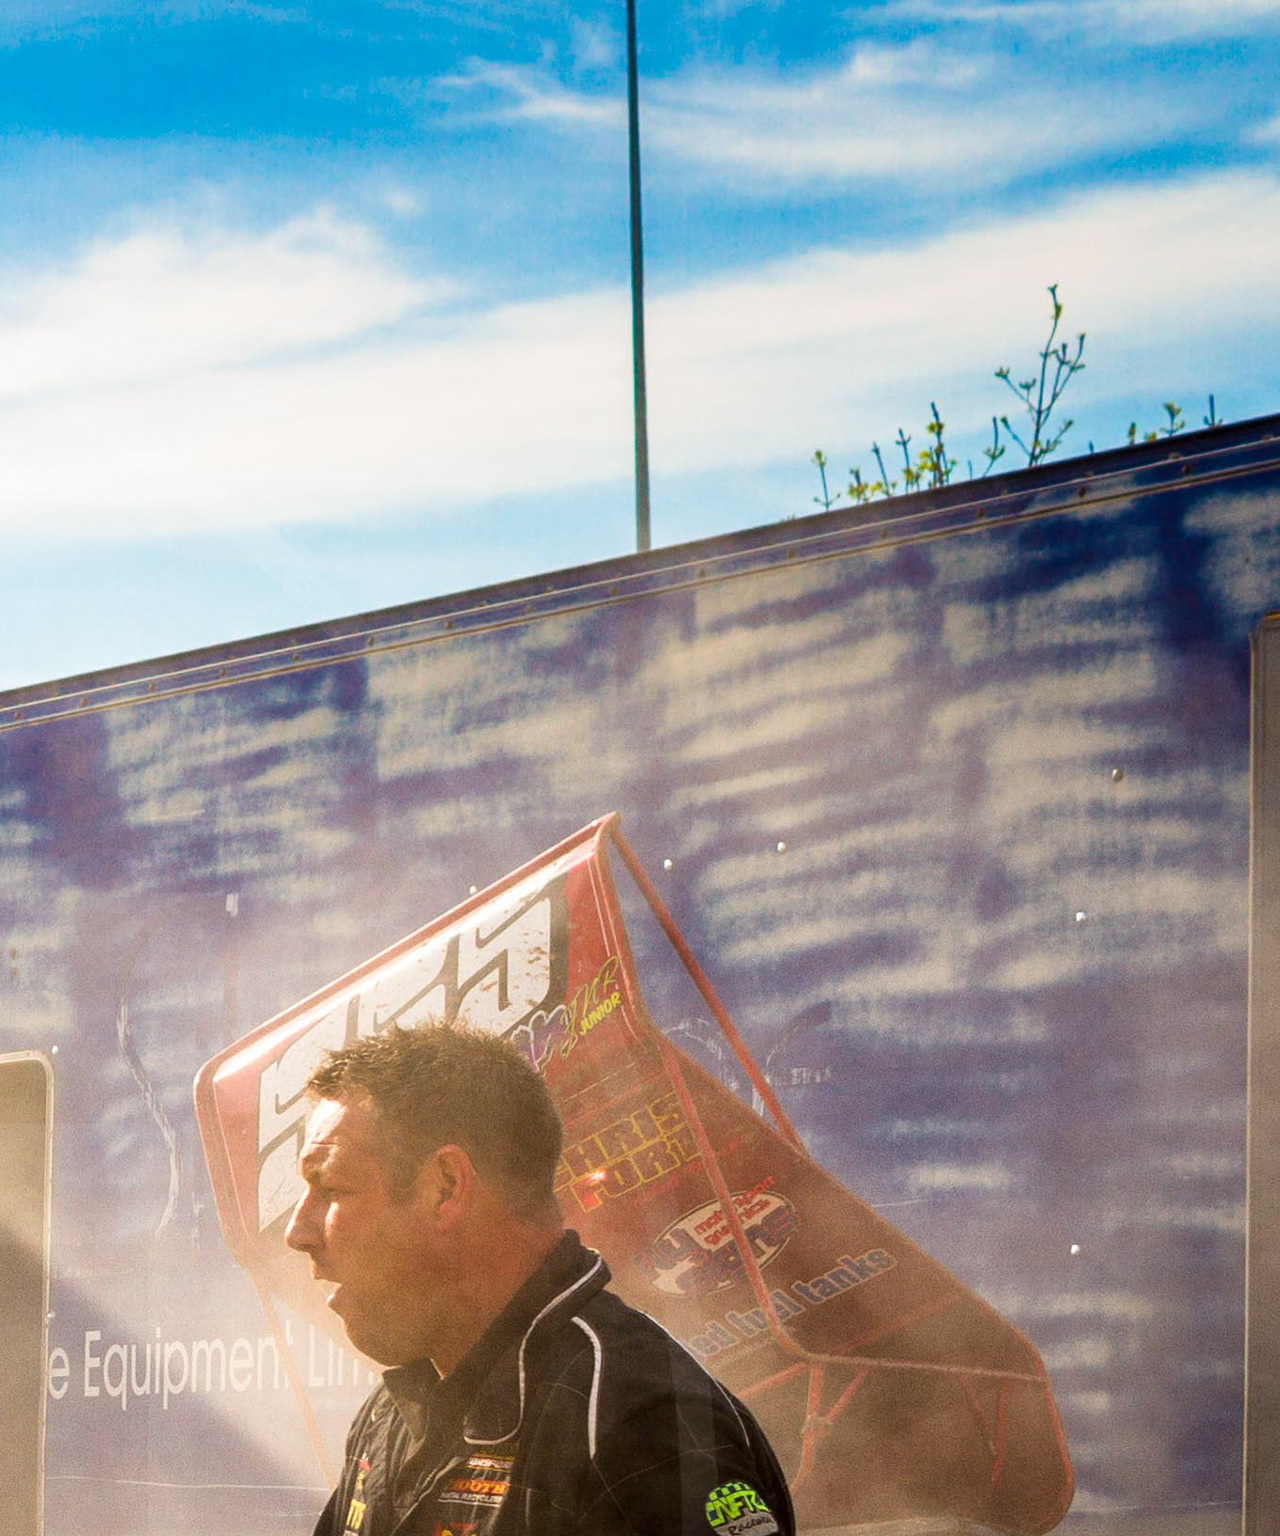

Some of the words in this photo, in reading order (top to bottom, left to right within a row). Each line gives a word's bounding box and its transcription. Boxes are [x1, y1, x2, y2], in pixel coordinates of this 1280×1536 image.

[579, 991, 621, 1036] JUNIOR
[791, 1248, 899, 1304] tanks
[84, 1328, 293, 1411] Equipment
